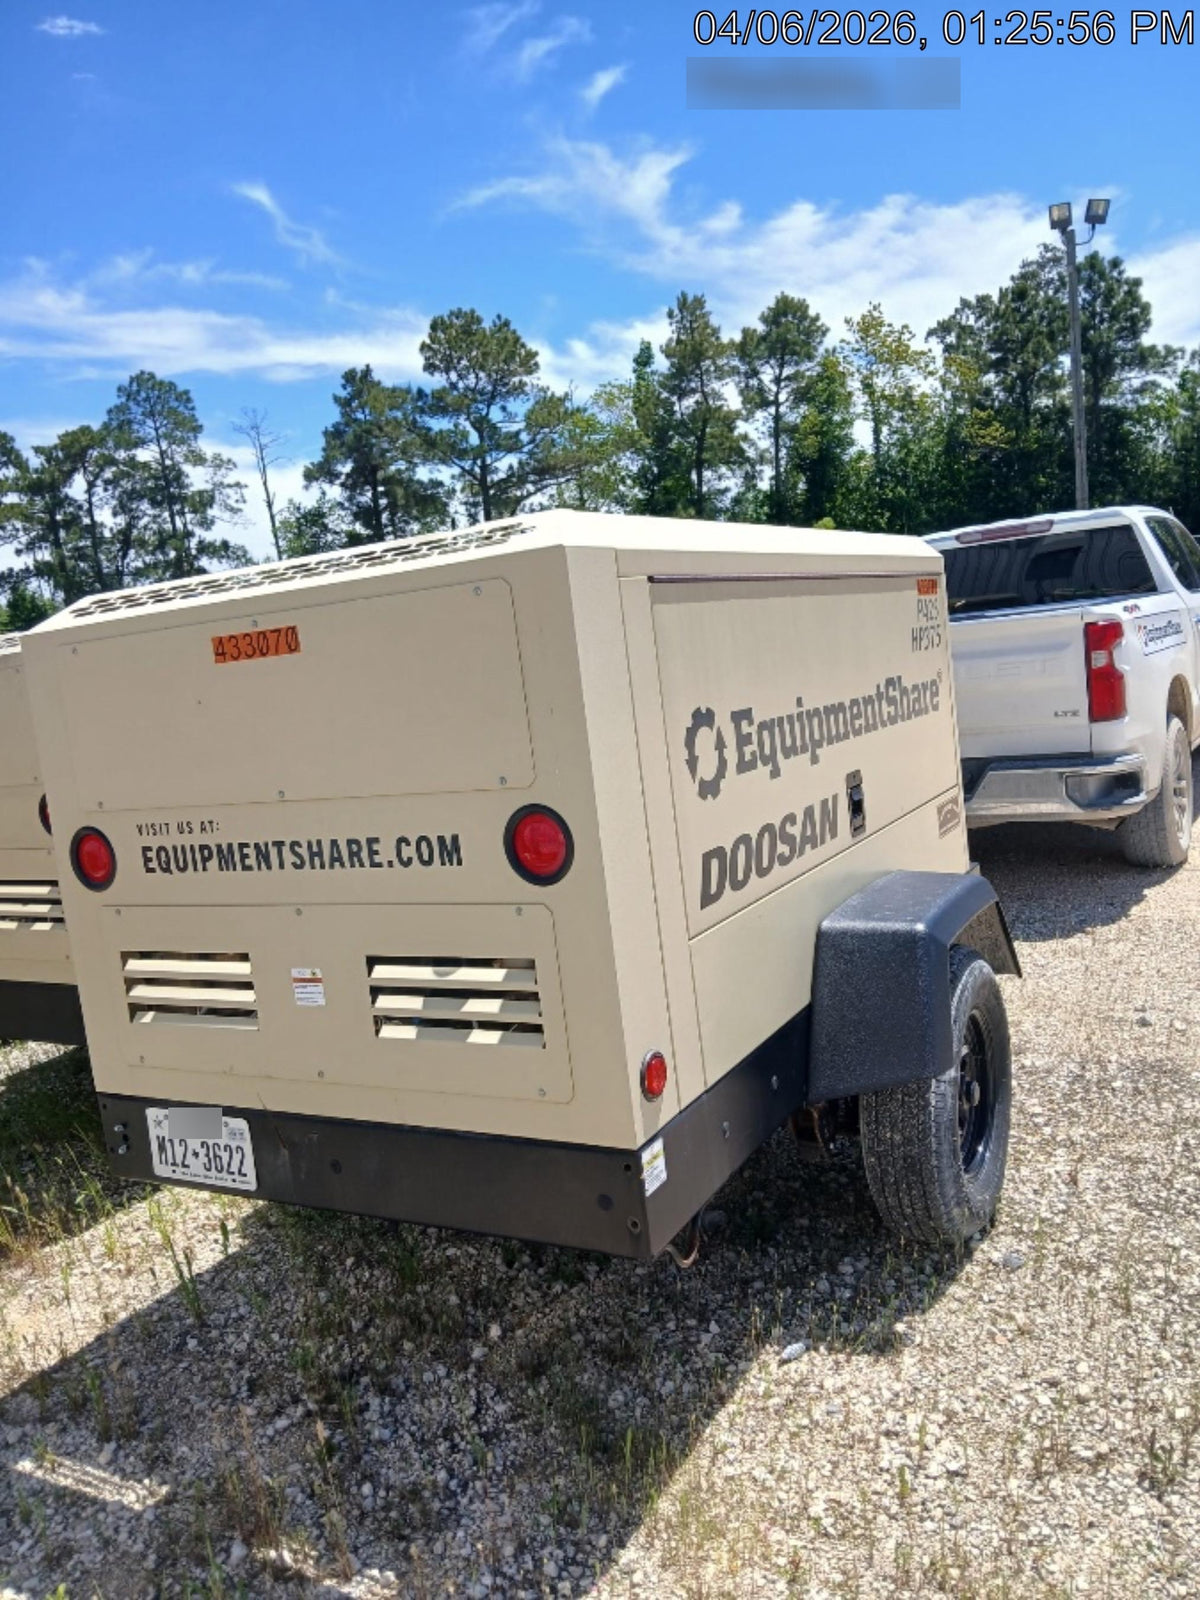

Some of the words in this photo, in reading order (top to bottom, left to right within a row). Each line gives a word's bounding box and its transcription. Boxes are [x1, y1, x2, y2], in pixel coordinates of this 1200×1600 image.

[214, 625, 299, 663] 433070
[911, 624, 942, 652] HP375
[136, 822, 170, 836] VISIT
[177, 821, 194, 835] US
[200, 820, 220, 834] AT:
[141, 834, 464, 874] EQUIPMENTSHARE.COM
[700, 793, 839, 910] DOOSAN
